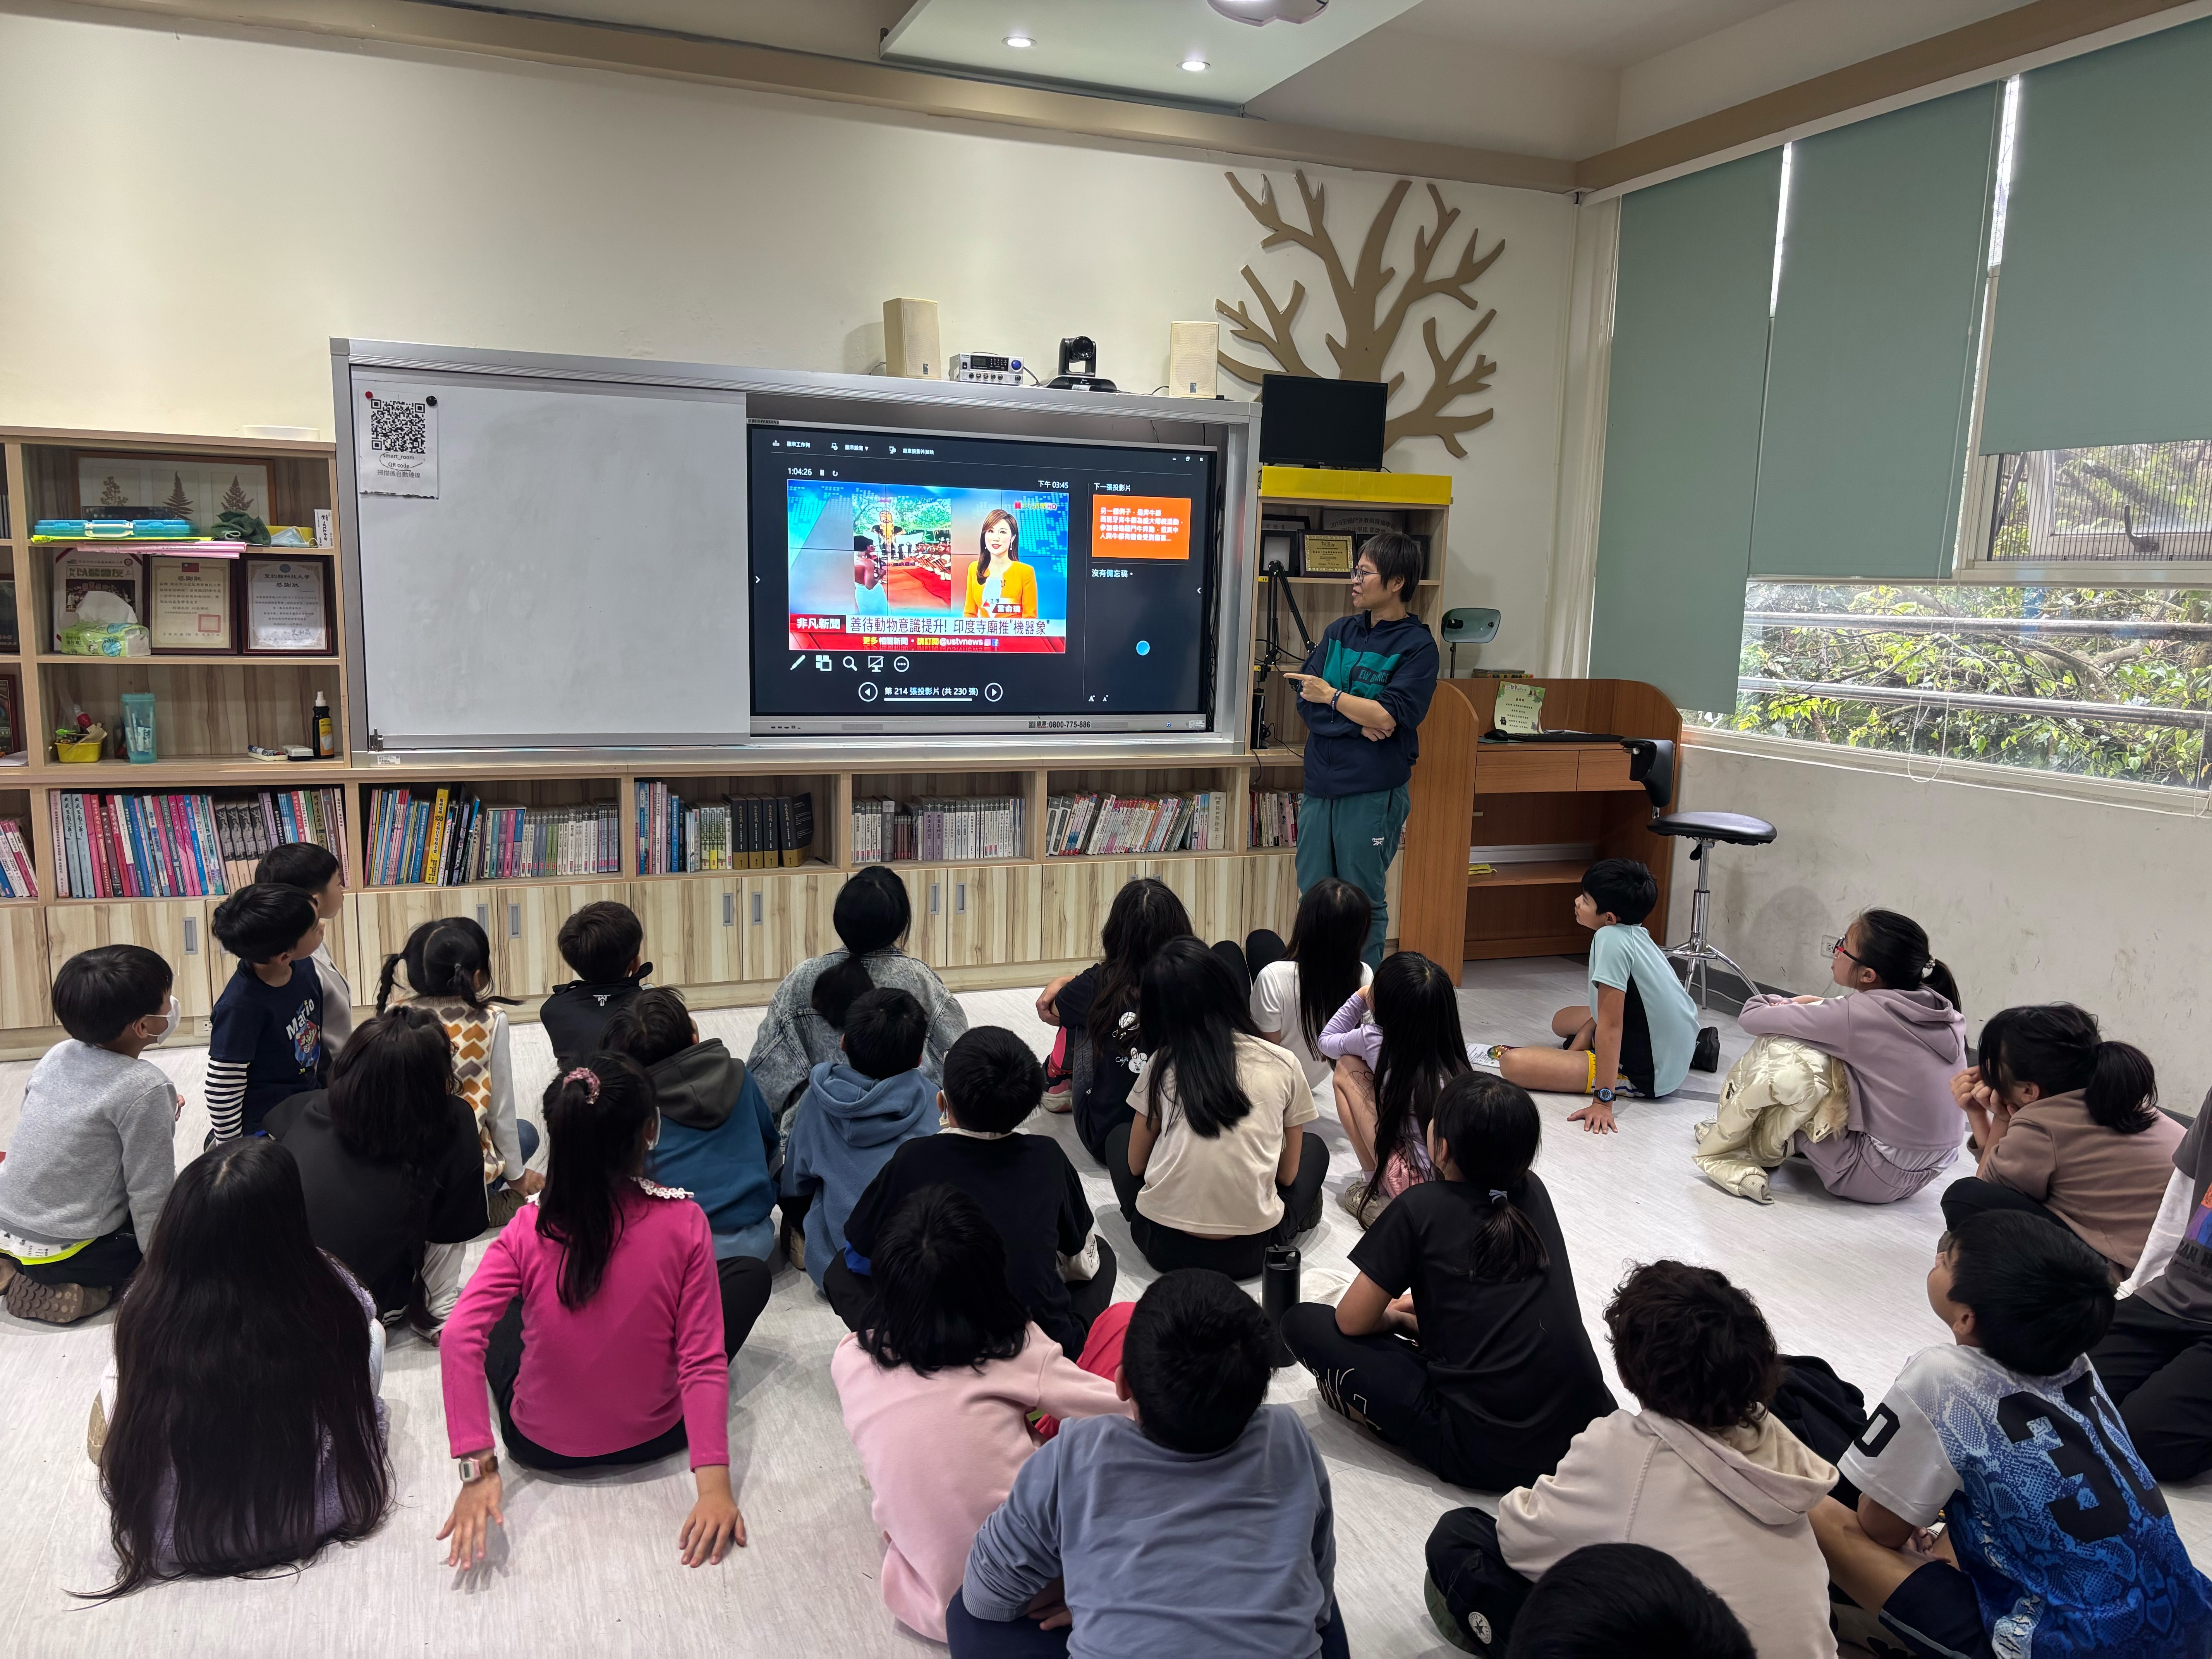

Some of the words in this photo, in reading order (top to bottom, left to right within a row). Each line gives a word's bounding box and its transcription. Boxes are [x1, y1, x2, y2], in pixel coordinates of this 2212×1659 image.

[788, 467, 812, 476] 1:04:26
[1038, 480, 1051, 488] 下午
[1052, 481, 1069, 489] 03:45
[1094, 483, 1131, 492] 下一張投影片
[797, 618, 840, 630] 非凡新聞
[884, 687, 892, 696] 第
[910, 687, 939, 696] 張投影片
[286, 999, 314, 1041] Mario
